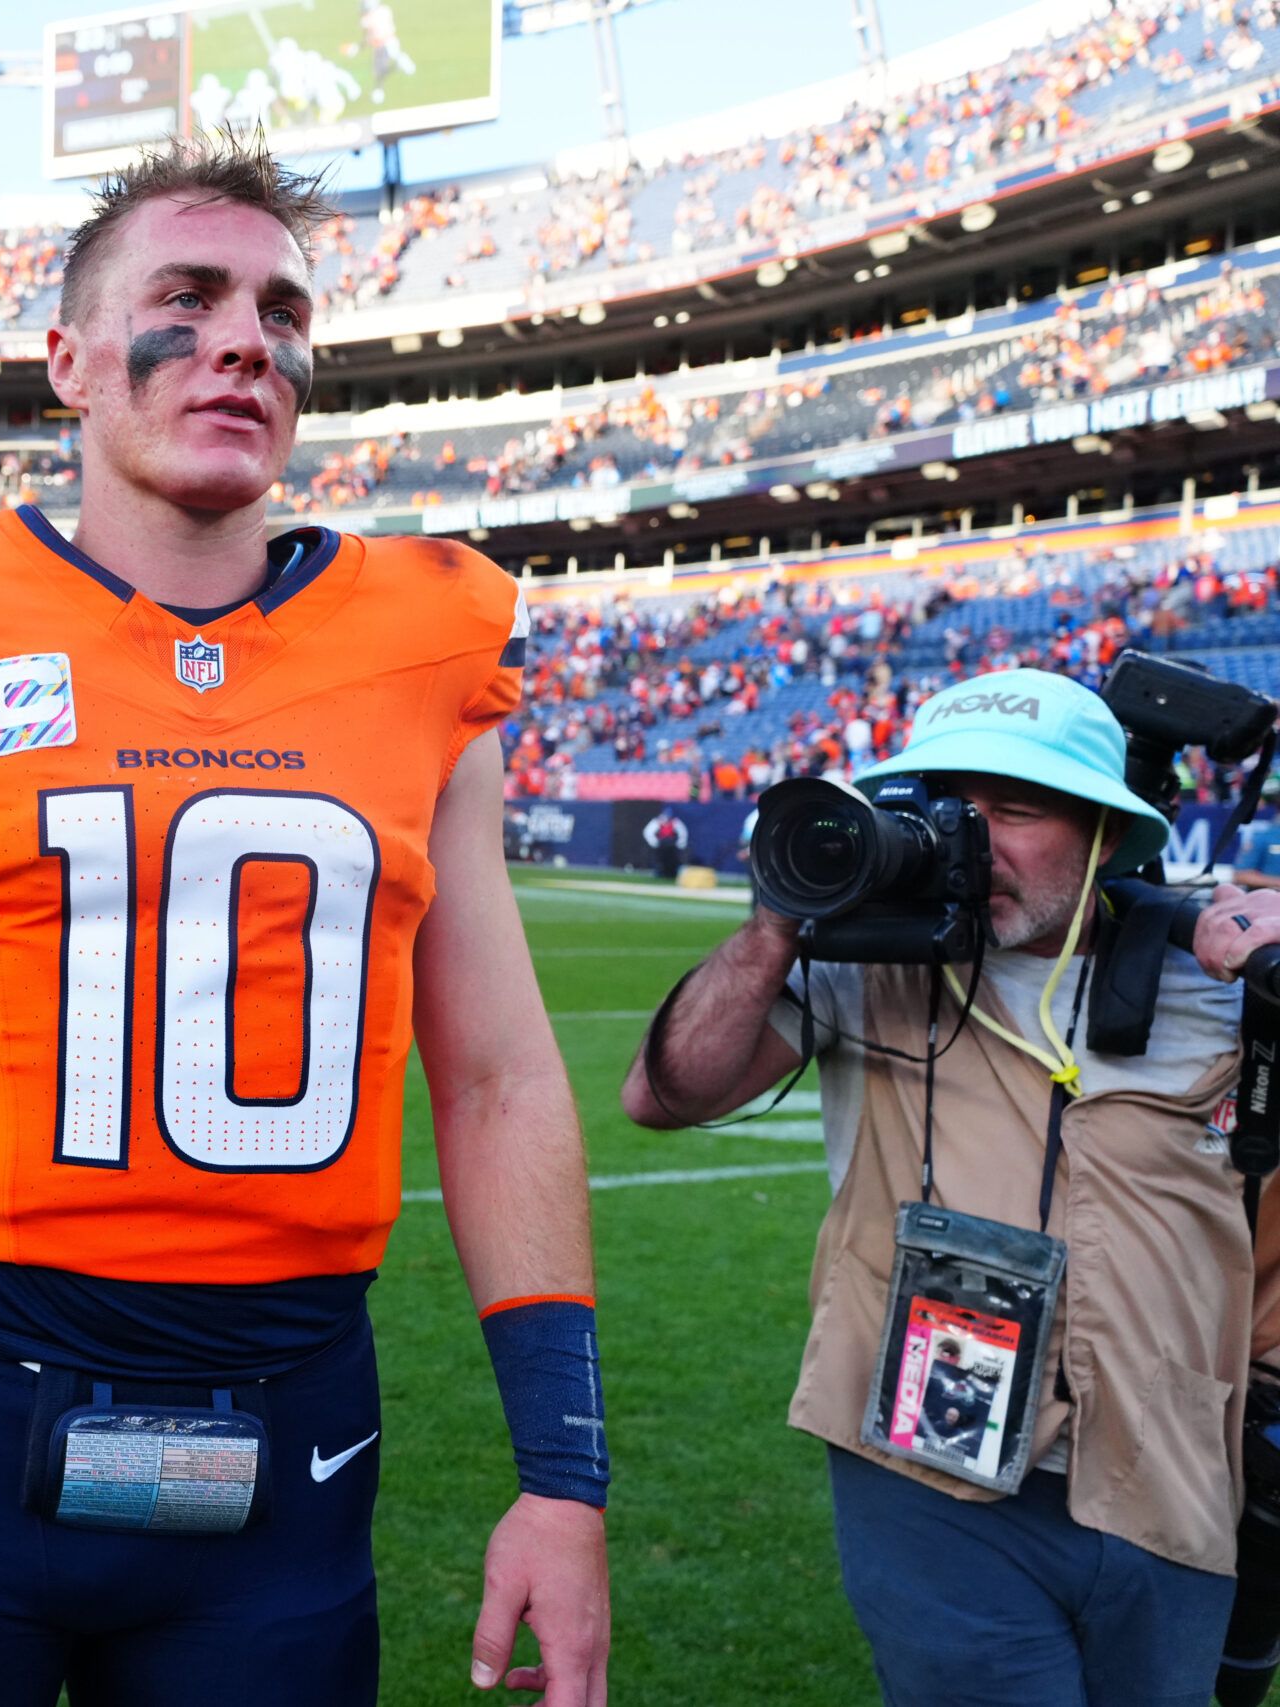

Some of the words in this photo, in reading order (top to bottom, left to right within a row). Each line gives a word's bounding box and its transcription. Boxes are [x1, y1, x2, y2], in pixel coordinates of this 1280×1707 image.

[184, 660, 216, 683] NFL
[927, 692, 1040, 726] HOKA
[116, 747, 306, 770] BRONCOS
[879, 786, 914, 797] Nikon
[37, 784, 381, 1174] 10
[1250, 1064, 1270, 1115] Nikon
[894, 1335, 928, 1435] MEDIA
